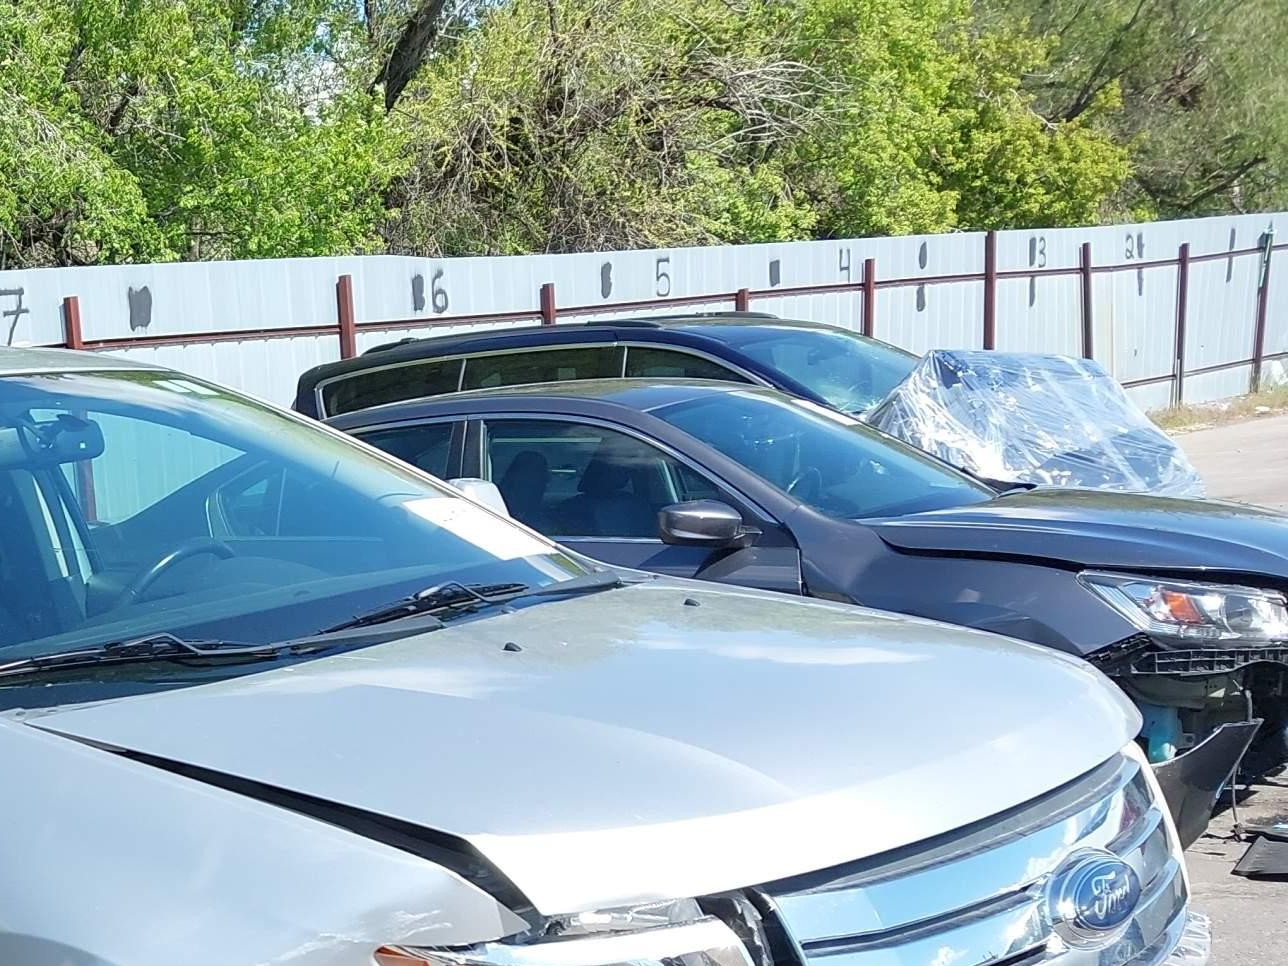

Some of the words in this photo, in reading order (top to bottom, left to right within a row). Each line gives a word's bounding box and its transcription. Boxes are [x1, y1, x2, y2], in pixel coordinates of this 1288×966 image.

[655, 256, 672, 298] 5
[838, 247, 851, 283] 4
[430, 266, 450, 315] 6
[1091, 870, 1131, 920] Ford
